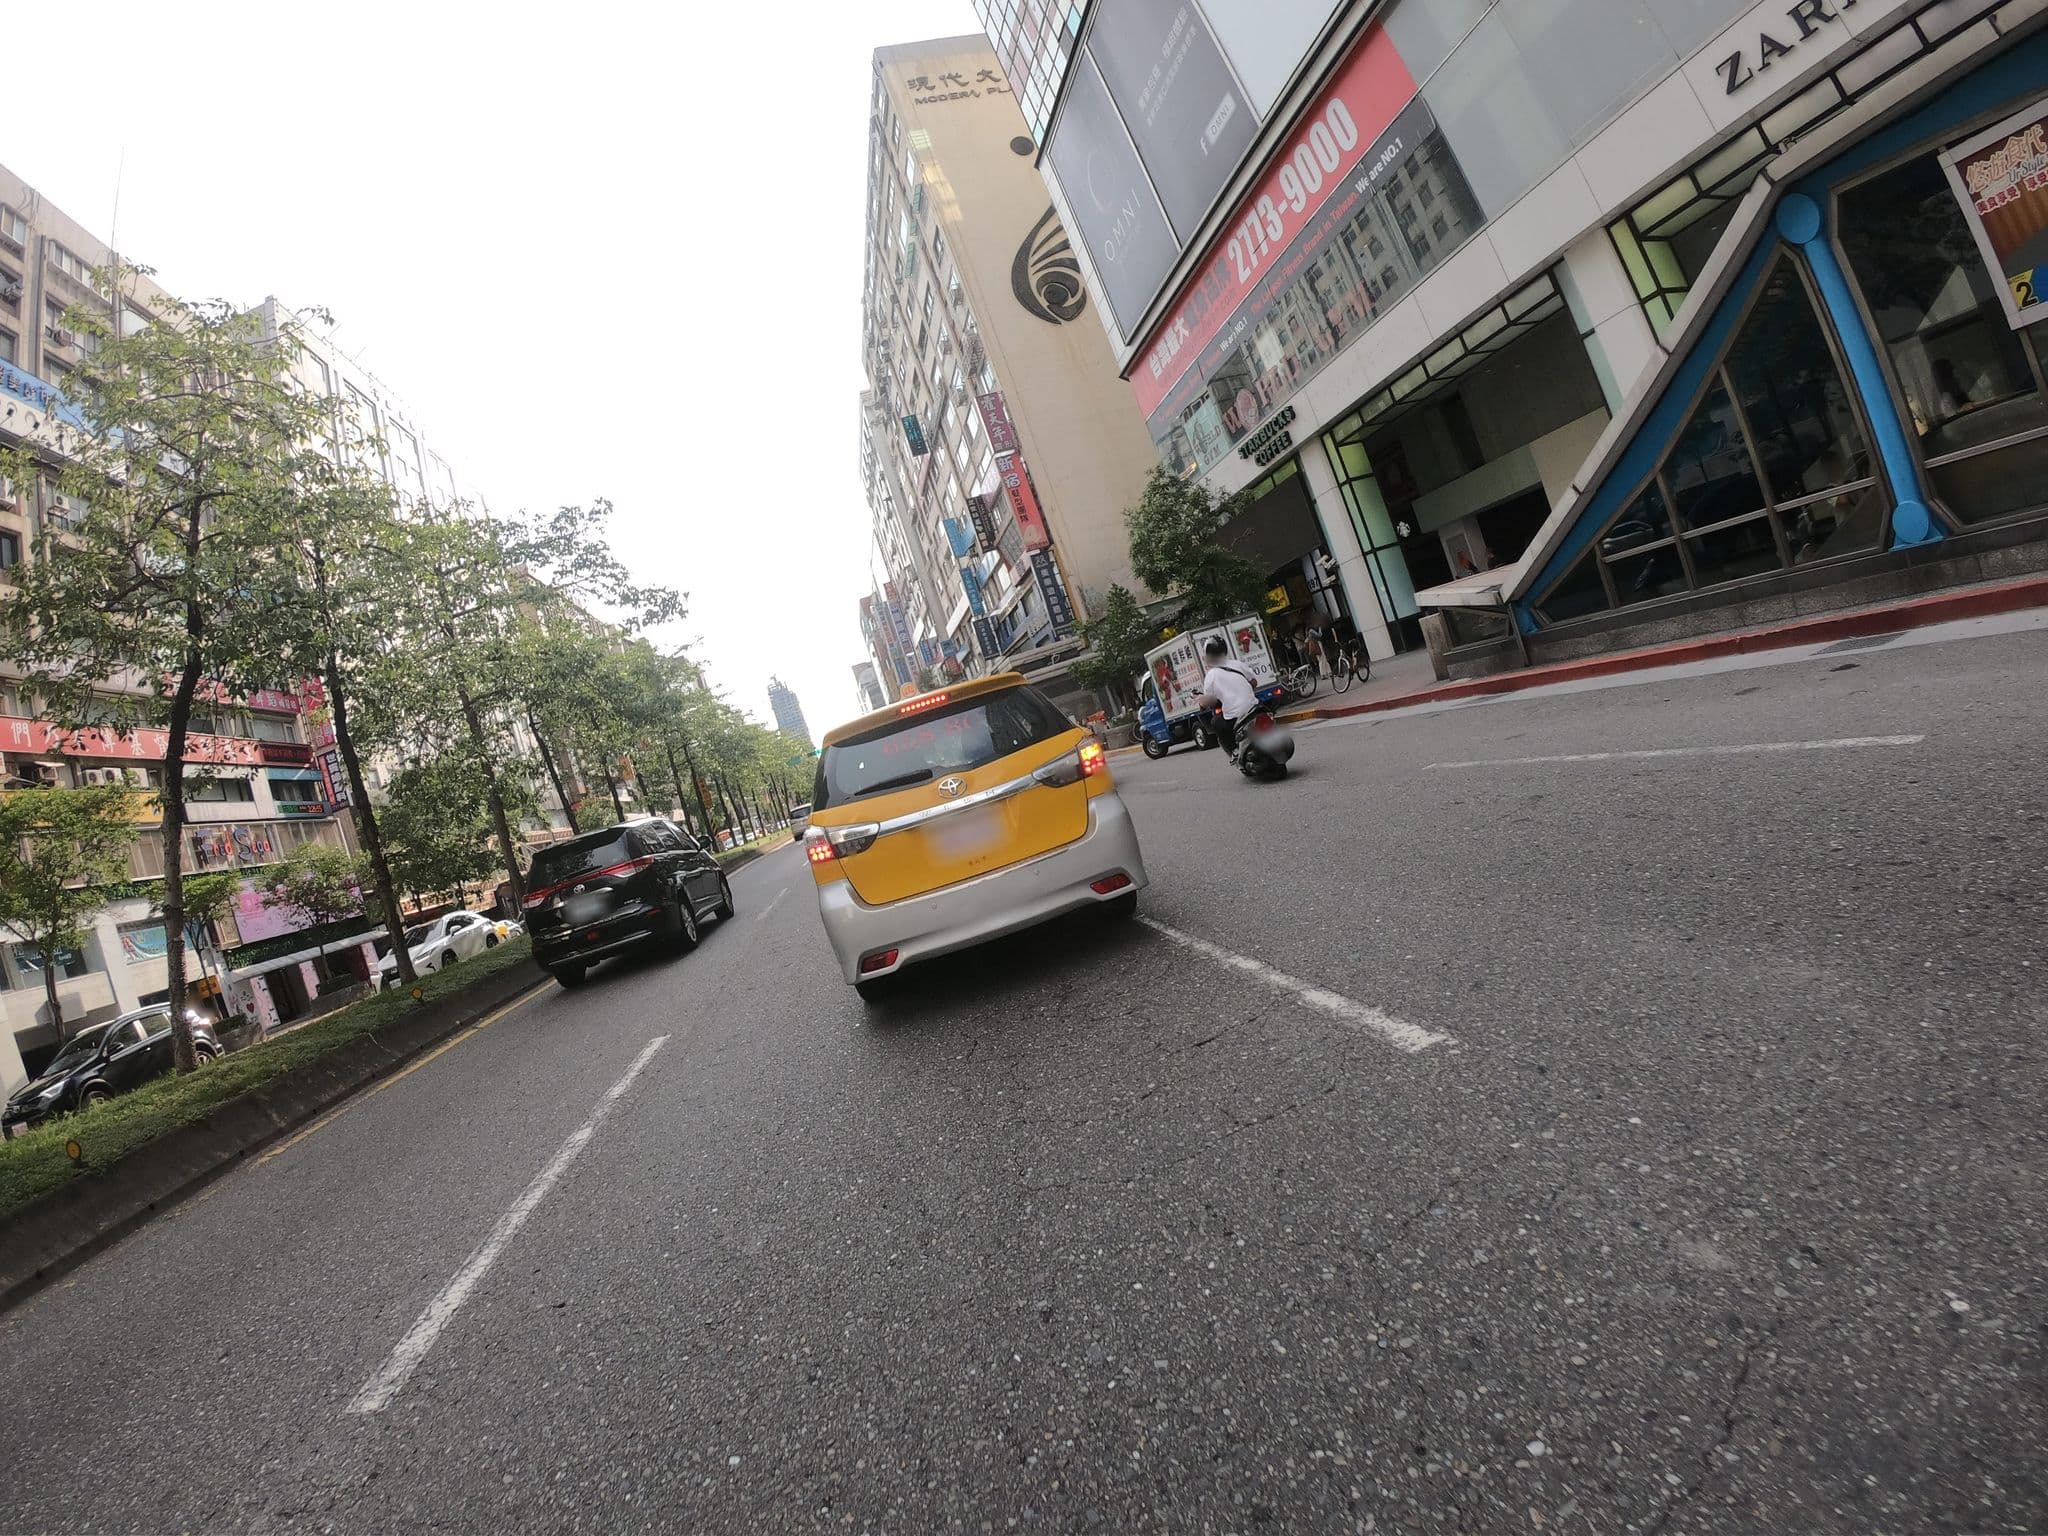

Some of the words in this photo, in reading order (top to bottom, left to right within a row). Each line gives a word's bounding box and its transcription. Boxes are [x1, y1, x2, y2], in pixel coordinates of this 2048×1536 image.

[1715, 0, 1857, 95] ZAR
[914, 88, 982, 106] MODERN
[1227, 97, 1359, 285] 2773-9000
[1354, 176, 1370, 195] We
[1368, 161, 1385, 182] are
[1380, 136, 1404, 167] NO.1
[1104, 187, 1142, 261] OMNI
[2015, 281, 2039, 308] 2
[1237, 405, 1297, 460] STARBUCKS
[1253, 430, 1293, 467] COFFEE
